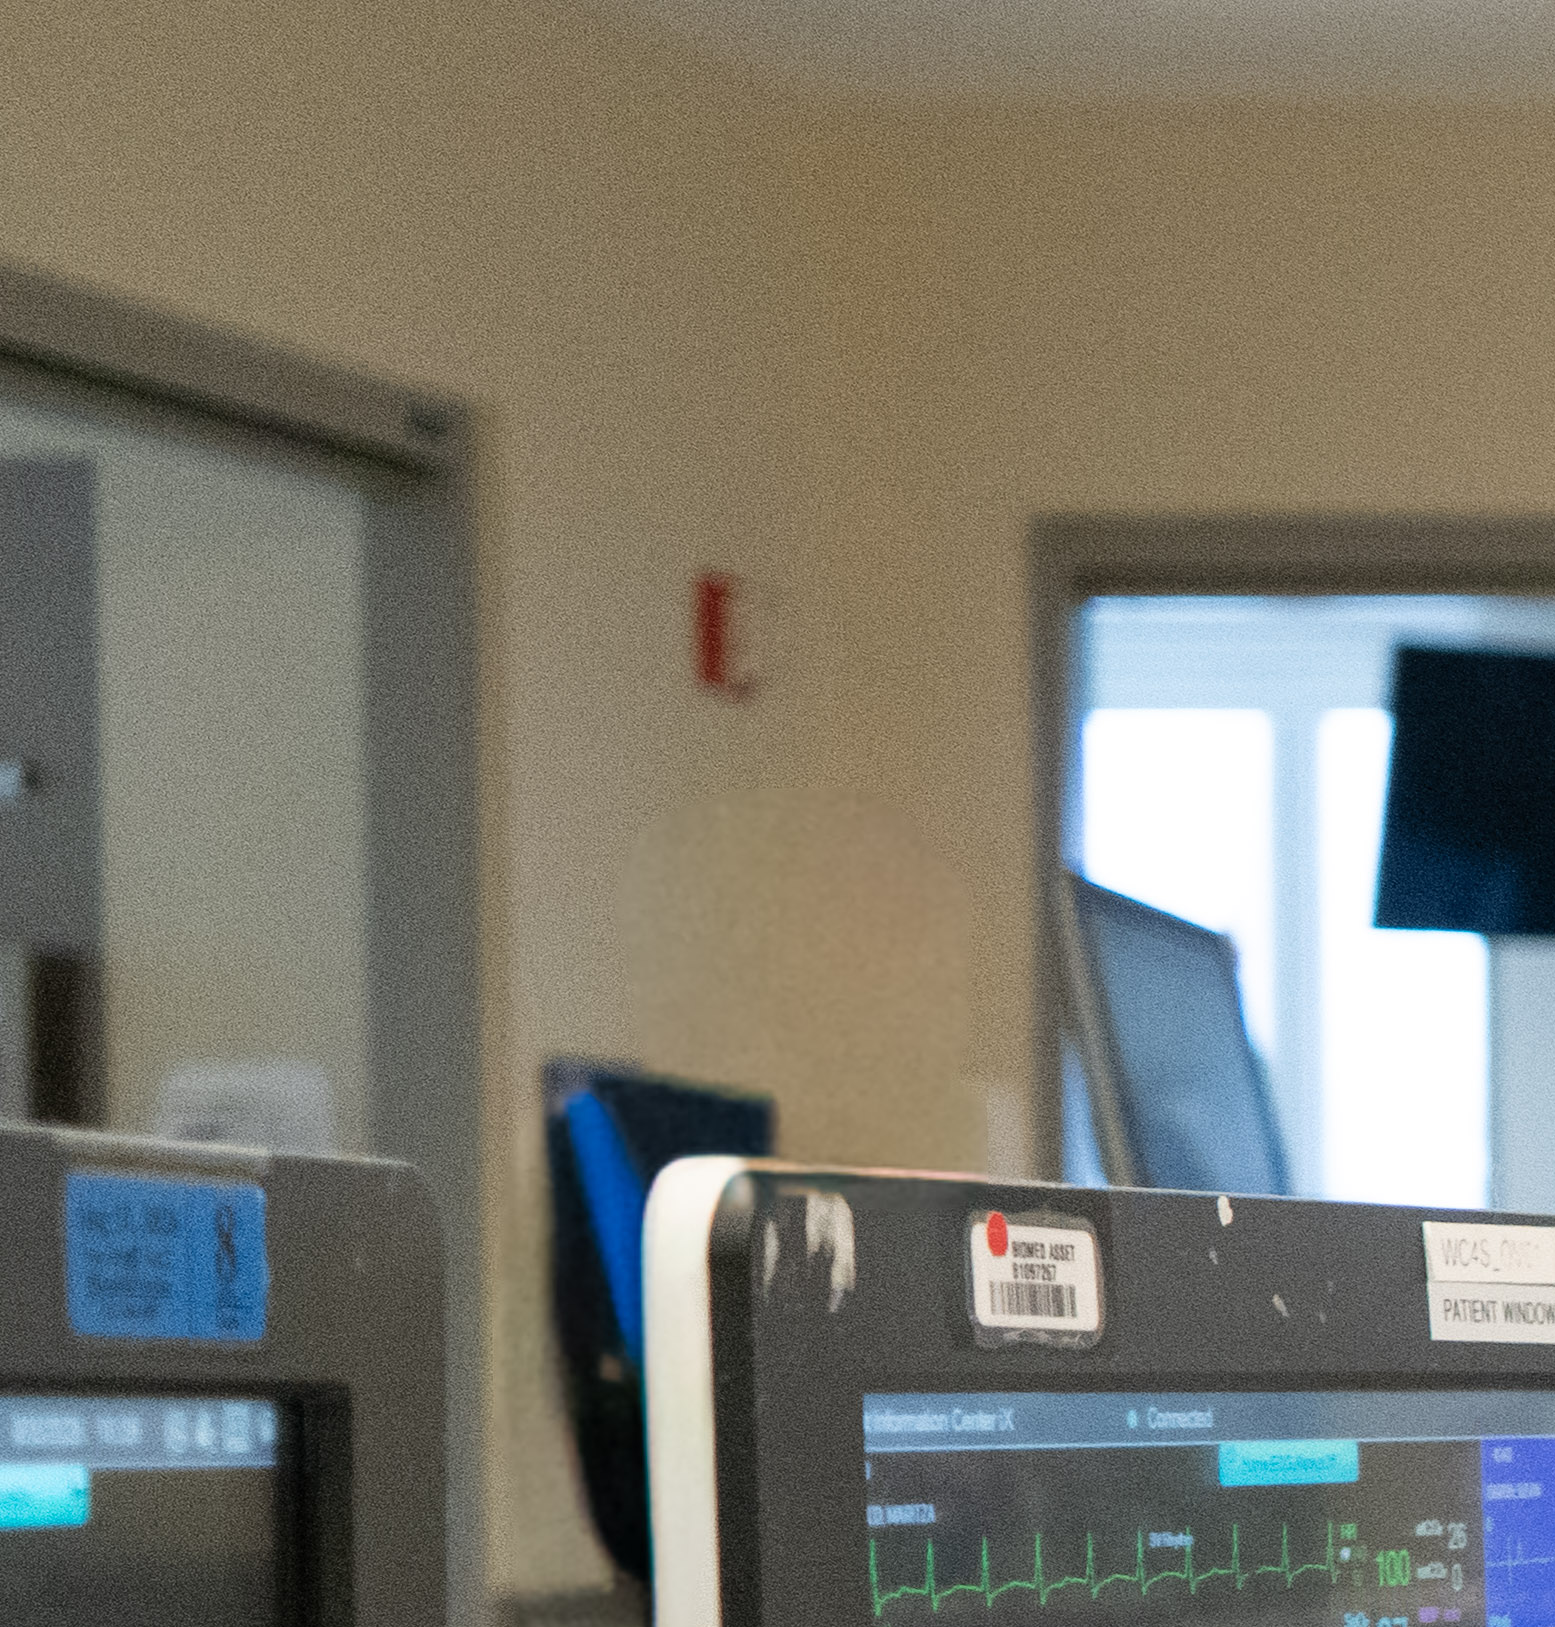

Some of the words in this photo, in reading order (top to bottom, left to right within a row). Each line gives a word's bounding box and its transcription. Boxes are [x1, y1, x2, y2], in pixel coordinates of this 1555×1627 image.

[1443, 1298, 1498, 1324] PATIENT
[1502, 1301, 1555, 1325] WINDOW
[1375, 1549, 1411, 1588] 100
